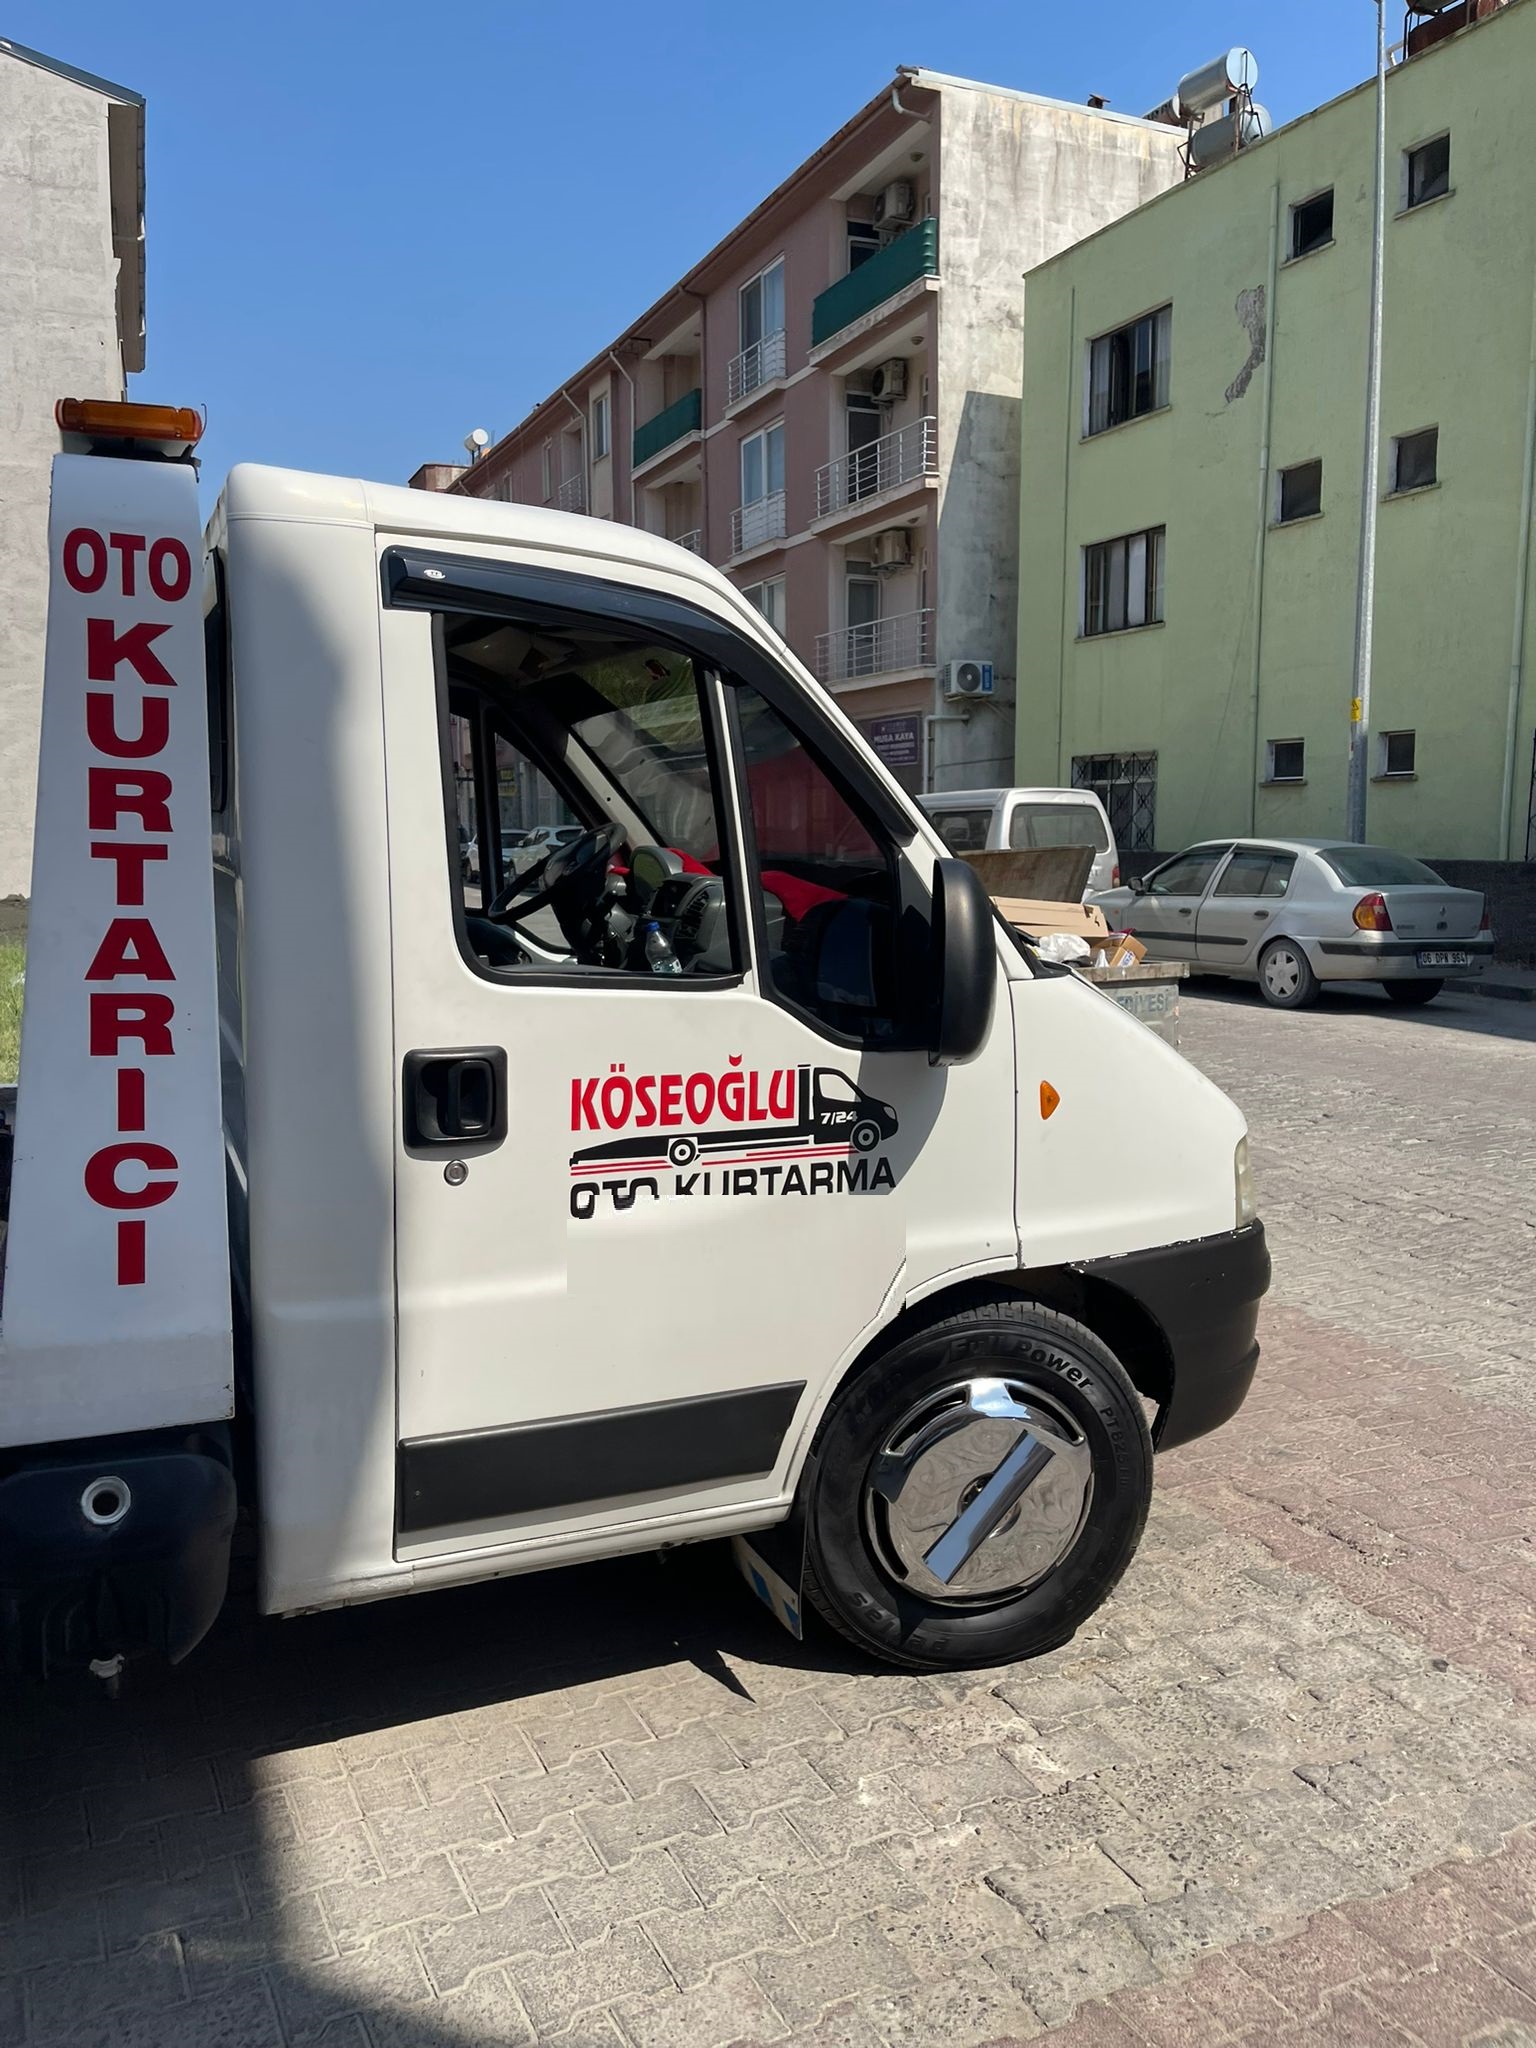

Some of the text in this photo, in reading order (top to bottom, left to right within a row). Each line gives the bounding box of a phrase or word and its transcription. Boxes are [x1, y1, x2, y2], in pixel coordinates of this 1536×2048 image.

[63, 527, 191, 602] OTO
[84, 618, 178, 1285] KURTARICI
[571, 1054, 796, 1131] KÖSEOĞLU
[820, 1110, 858, 1126] 7/24
[1012, 1338, 1094, 1390] Power
